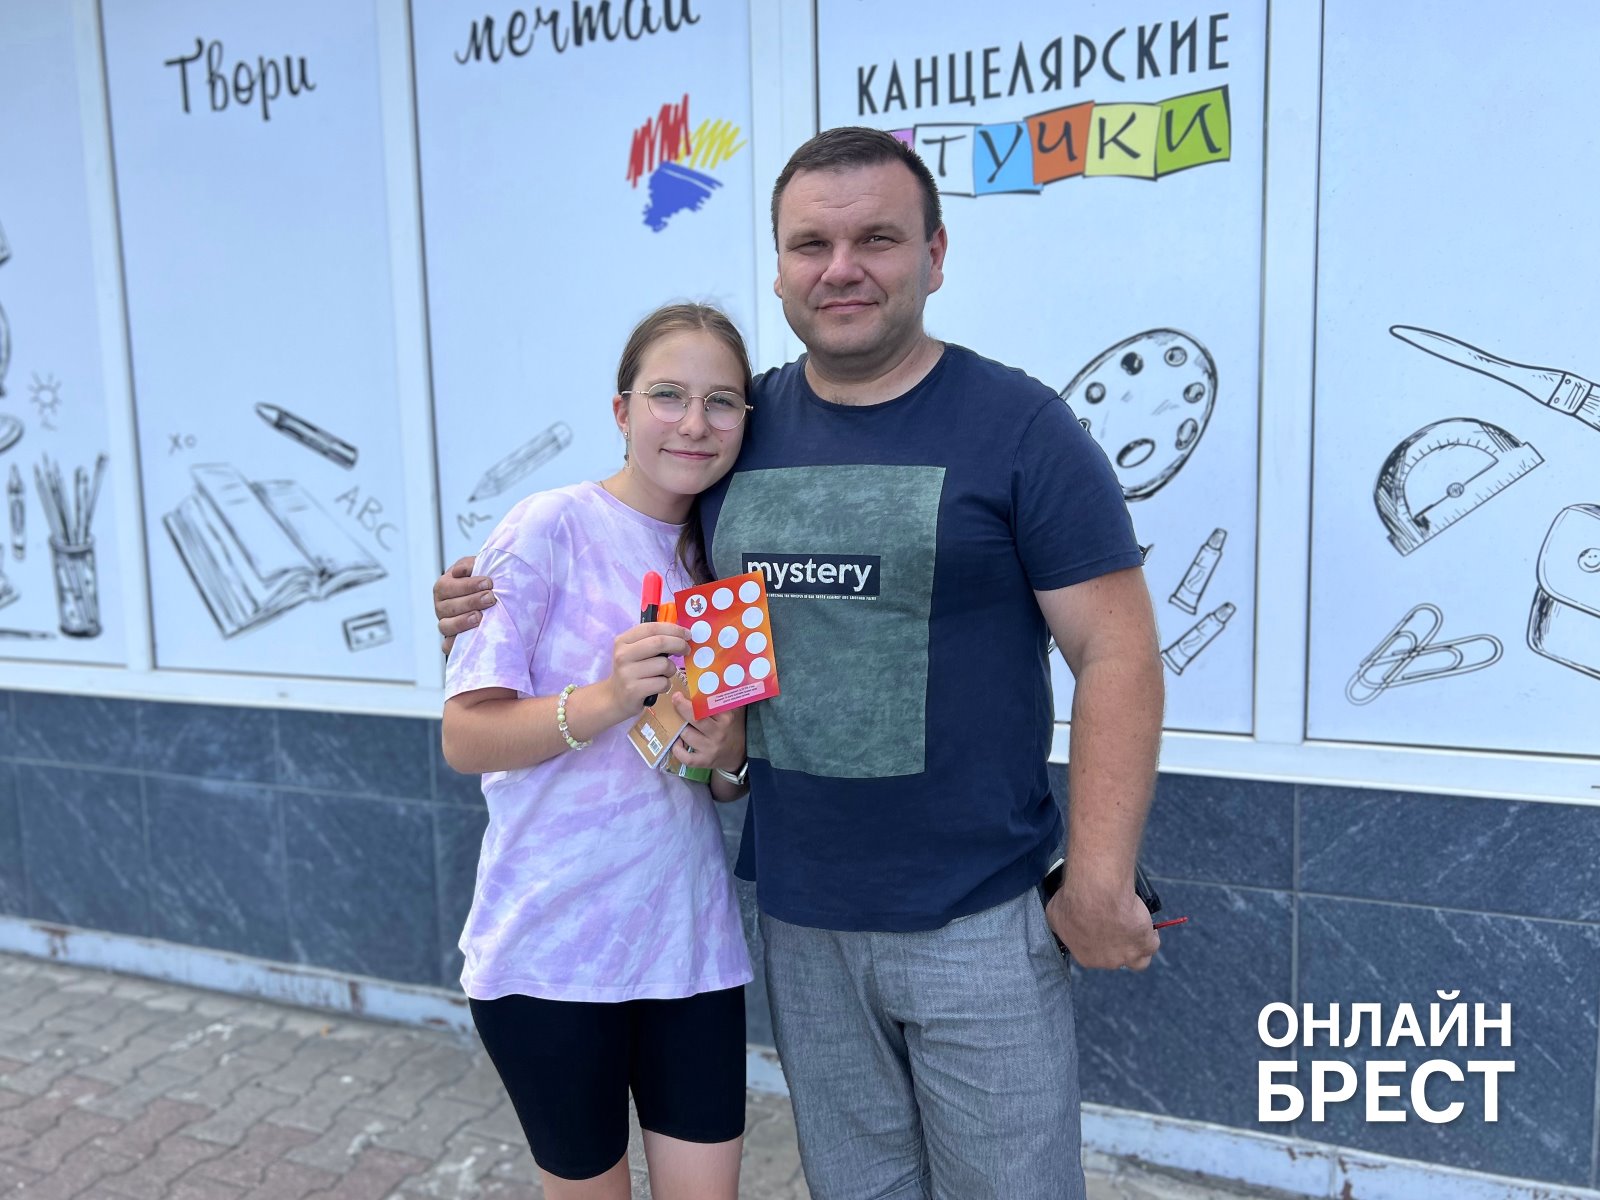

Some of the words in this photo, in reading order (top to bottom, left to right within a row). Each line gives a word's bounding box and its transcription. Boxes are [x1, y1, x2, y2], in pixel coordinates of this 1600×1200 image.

[164, 37, 317, 121] Твори
[857, 12, 1229, 116] КАНЦЕЛЯРСКИЕ
[902, 102, 1223, 183] ТУЧКИ
[334, 485, 399, 551] ABC
[747, 558, 873, 592] mystery
